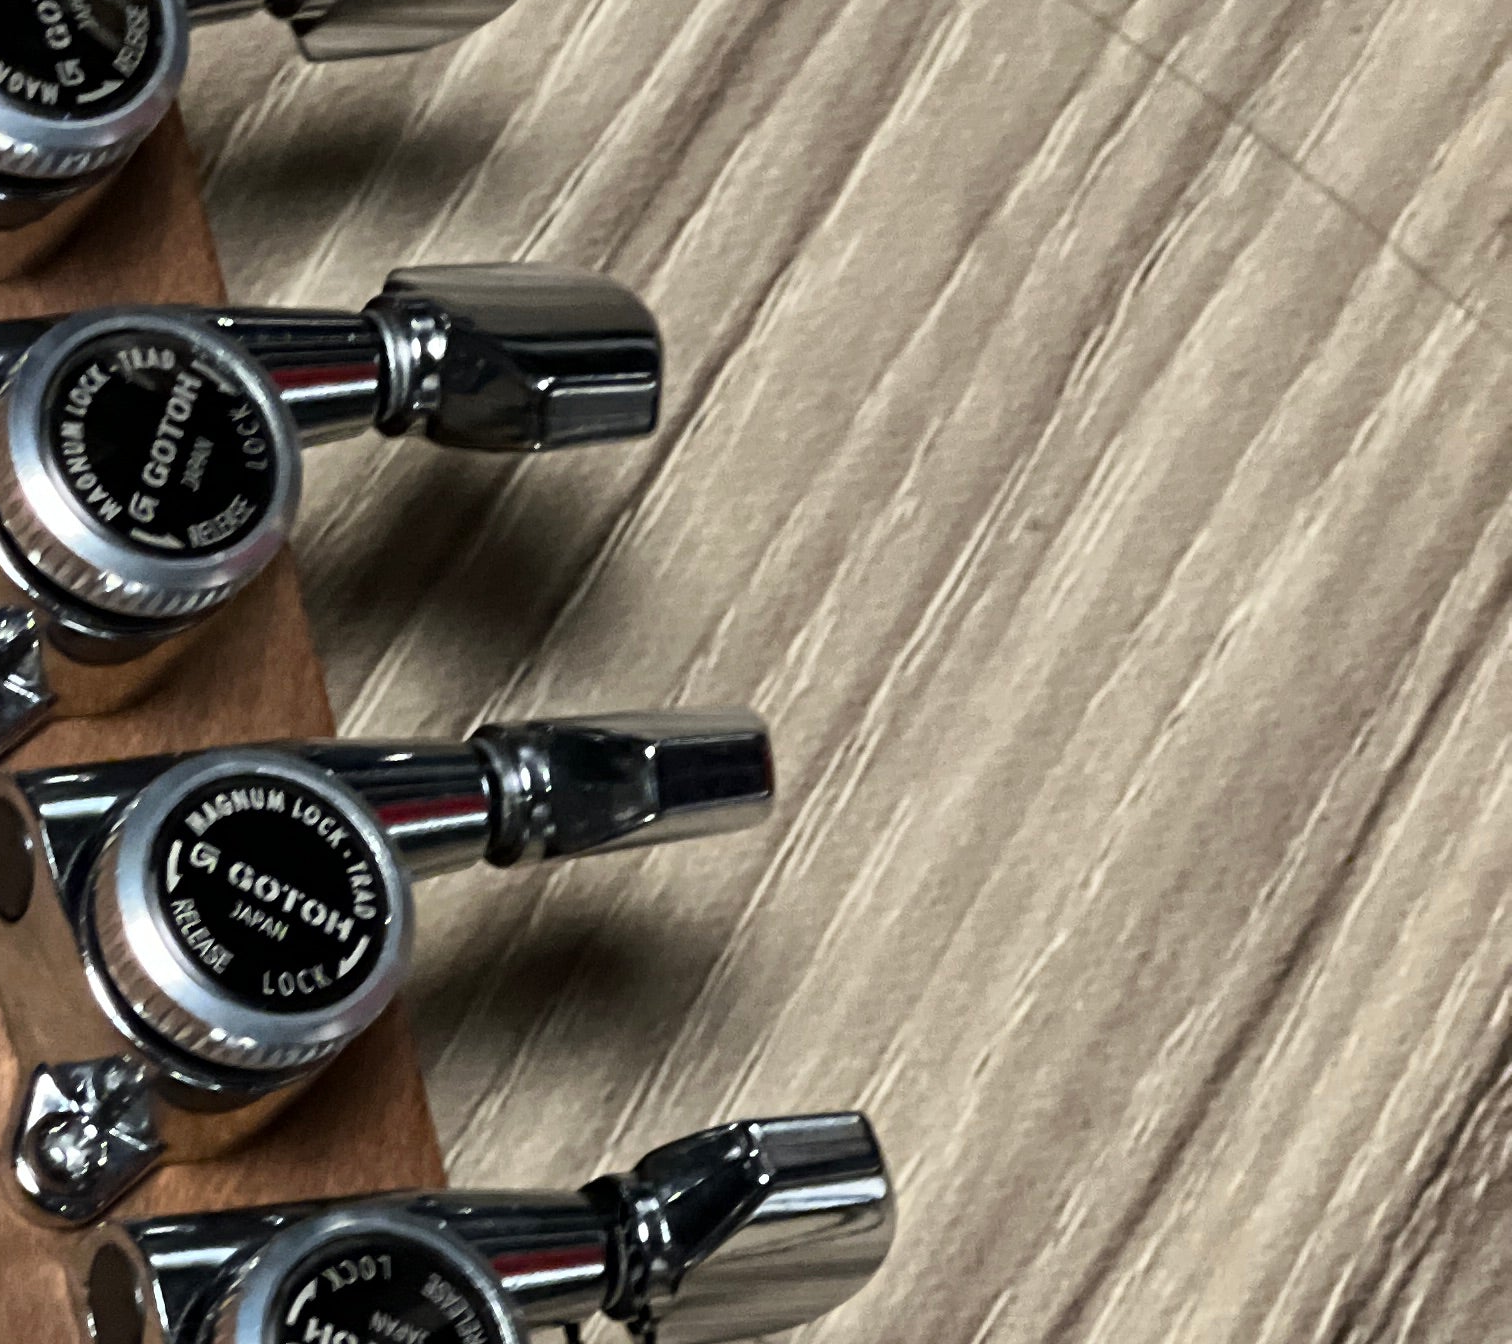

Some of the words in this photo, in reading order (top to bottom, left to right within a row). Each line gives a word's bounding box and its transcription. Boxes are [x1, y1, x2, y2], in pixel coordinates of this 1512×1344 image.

[66, 362, 112, 416] LOCK
[142, 371, 202, 488] GOTOH
[228, 403, 268, 470] LOCK
[60, 421, 122, 522] MAGNUM
[185, 787, 286, 836] MAGNUM
[291, 796, 352, 850] LOCK
[347, 859, 377, 920] TRAD
[171, 898, 234, 974] RELEASE
[228, 861, 355, 942] GOTOH
[229, 900, 289, 942] JAPAN
[262, 963, 334, 996] LOCK
[321, 1254, 392, 1292] LOCK
